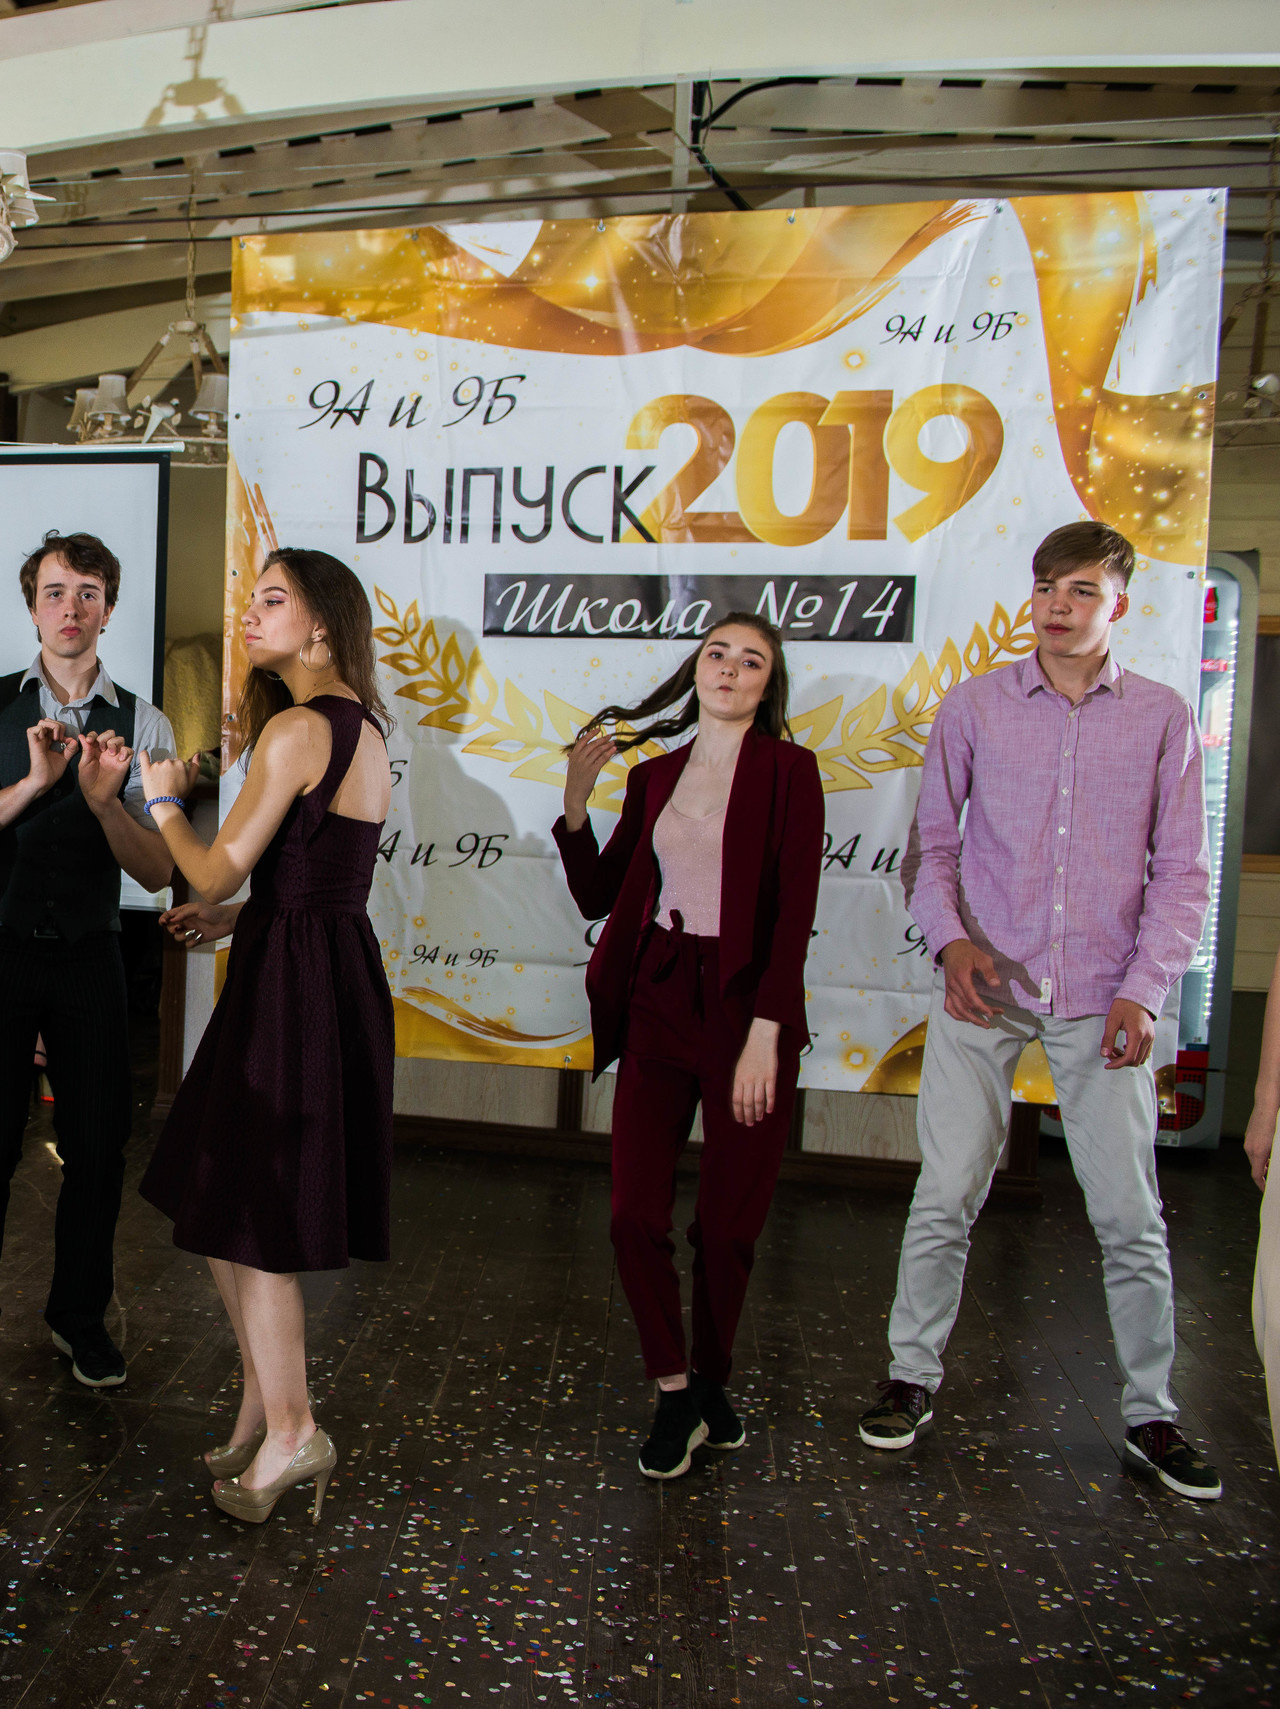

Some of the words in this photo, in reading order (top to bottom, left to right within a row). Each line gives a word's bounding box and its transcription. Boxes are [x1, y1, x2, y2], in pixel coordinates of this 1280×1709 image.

[879, 314, 927, 344] 9А
[933, 324, 957, 344] и
[966, 311, 1019, 341] 9Б
[298, 379, 375, 429] 9А
[389, 395, 426, 428] и
[442, 374, 526, 425] 9Б
[356, 452, 659, 544] Выпуск
[622, 383, 1004, 547] 2019
[495, 580, 716, 636] Школа
[376, 829, 402, 863] А
[410, 842, 438, 867] и
[448, 832, 510, 869] 9Б
[871, 847, 901, 873] и
[409, 944, 440, 966] 9А
[444, 951, 460, 967] и
[465, 948, 499, 968] 9Б
